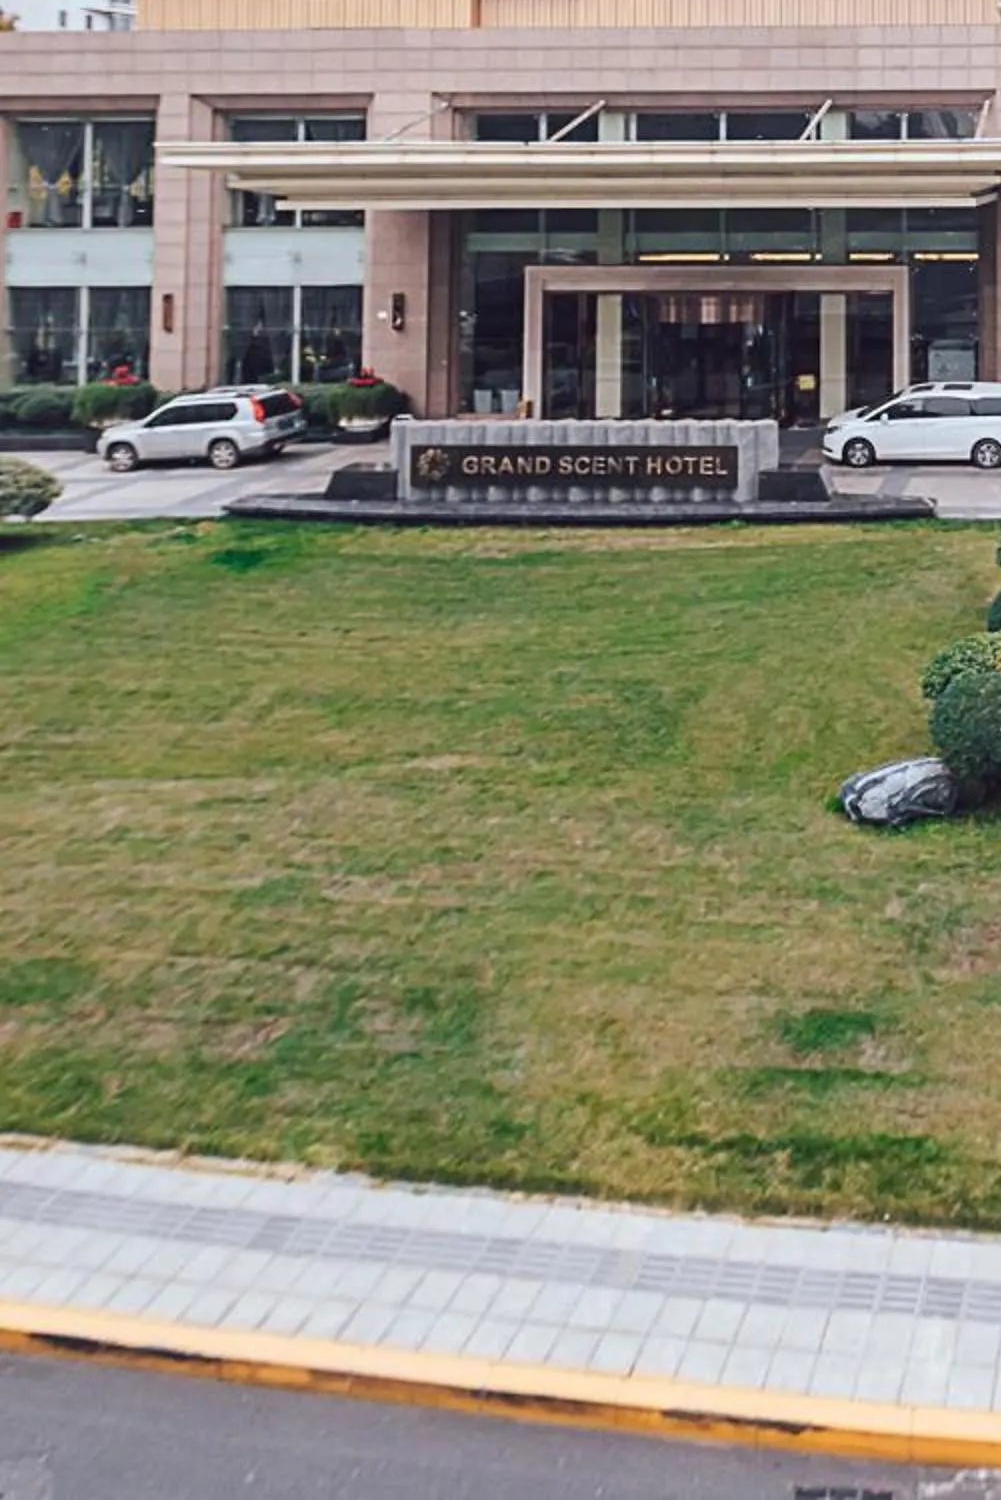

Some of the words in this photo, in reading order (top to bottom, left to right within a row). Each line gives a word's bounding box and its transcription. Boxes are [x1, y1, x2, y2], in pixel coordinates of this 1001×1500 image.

[462, 455, 550, 475] GRAND
[558, 455, 639, 475] SCENT
[646, 455, 728, 476] HOTEL
